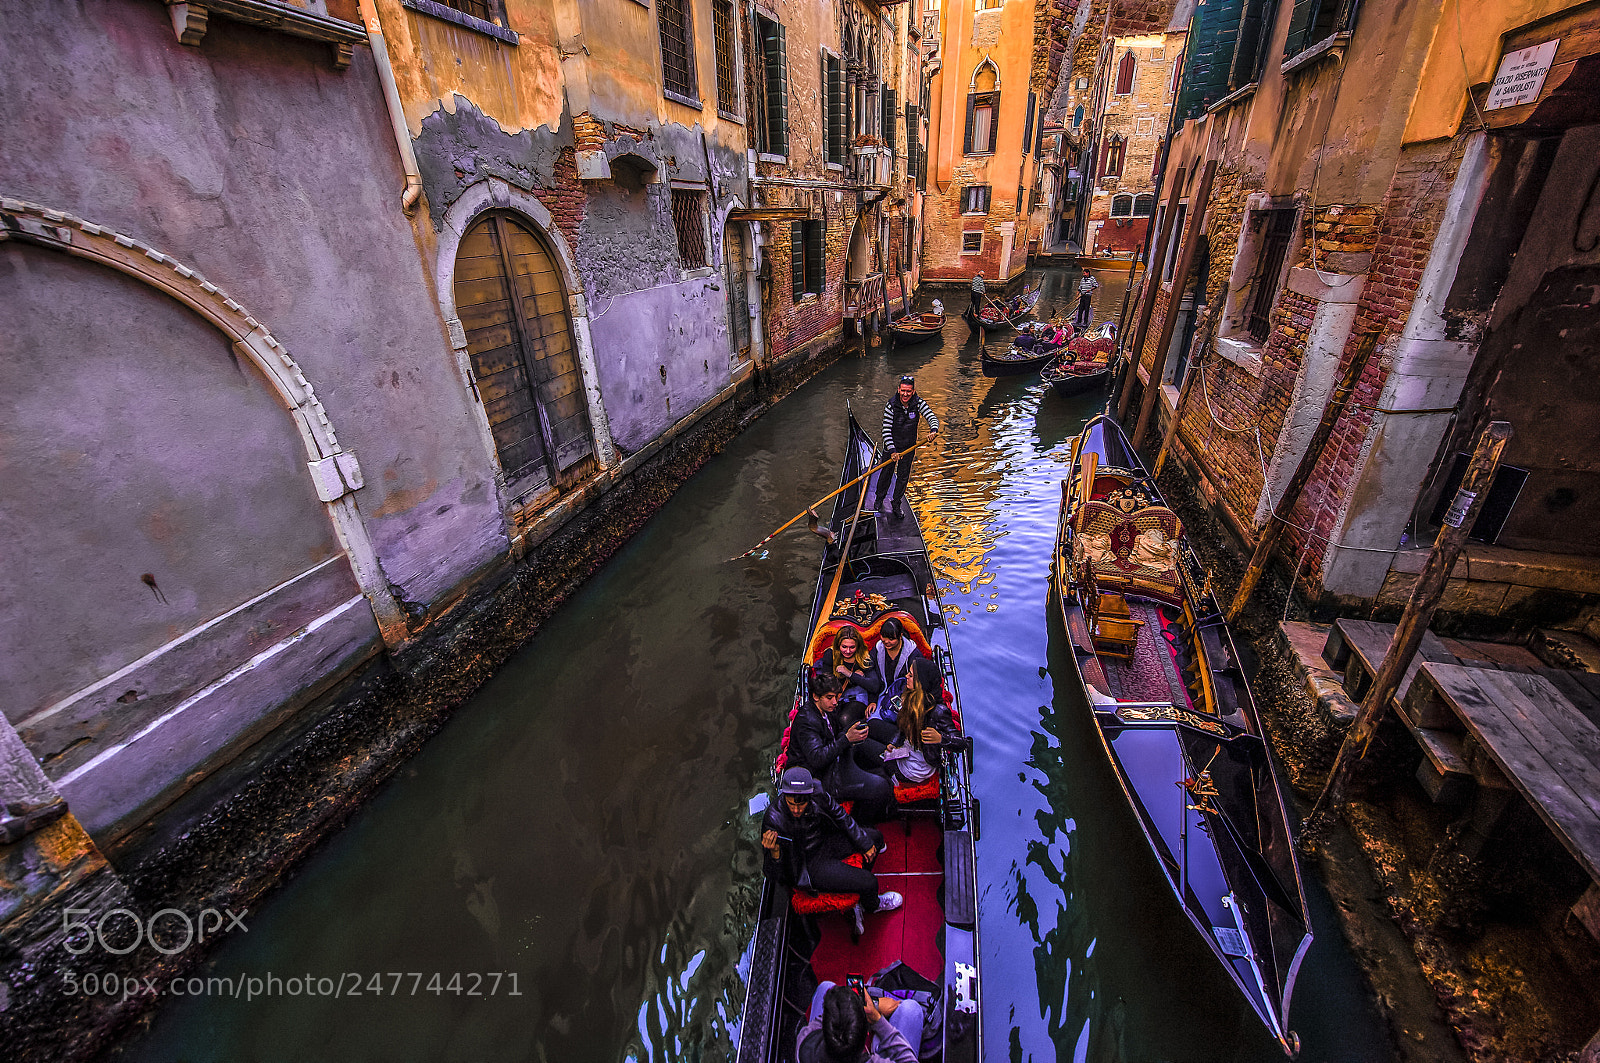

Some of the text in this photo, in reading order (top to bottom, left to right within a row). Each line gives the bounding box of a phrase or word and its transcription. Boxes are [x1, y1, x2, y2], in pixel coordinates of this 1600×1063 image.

[1494, 67, 1546, 86] STAZIO RISERVATO
[1495, 81, 1536, 96] AI SANDOLISTI
